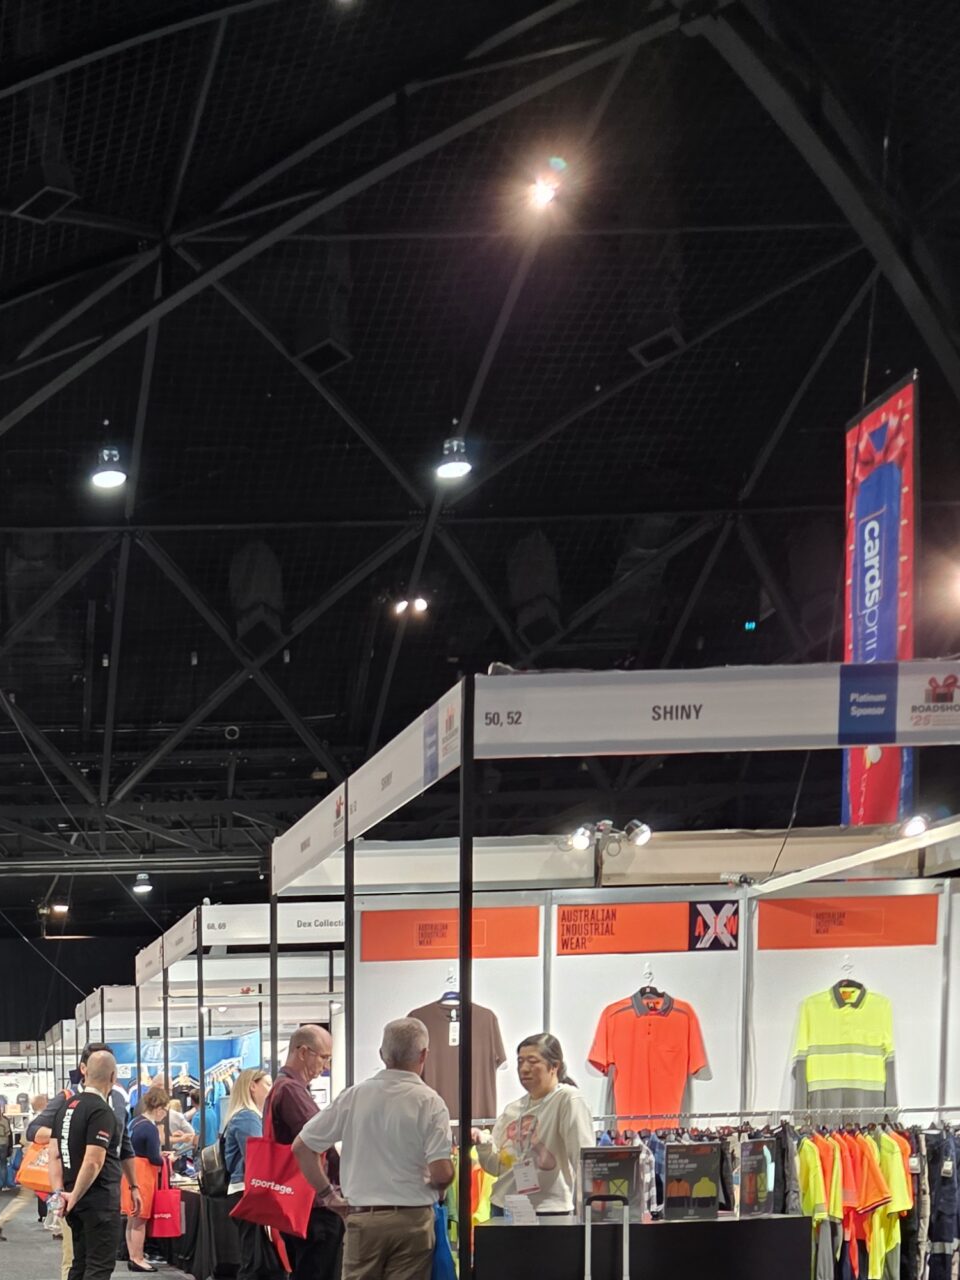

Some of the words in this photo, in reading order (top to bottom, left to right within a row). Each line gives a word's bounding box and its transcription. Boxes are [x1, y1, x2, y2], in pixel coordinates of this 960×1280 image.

[862, 519, 881, 664] cardsprin
[850, 692, 887, 703] Platinum
[651, 704, 704, 721] SHINY
[850, 705, 886, 717] Sponsor
[910, 703, 960, 714] ROADSHO
[484, 712, 504, 728] 50,
[506, 711, 523, 726] 52
[561, 909, 617, 923] AUSTRALIAN
[296, 919, 312, 928] Dex
[313, 919, 344, 928] Collecti
[561, 923, 615, 936] INDUSTRIAL
[60, 1108, 75, 1169] EQUIPMENT
[249, 1177, 295, 1196] sportage.
